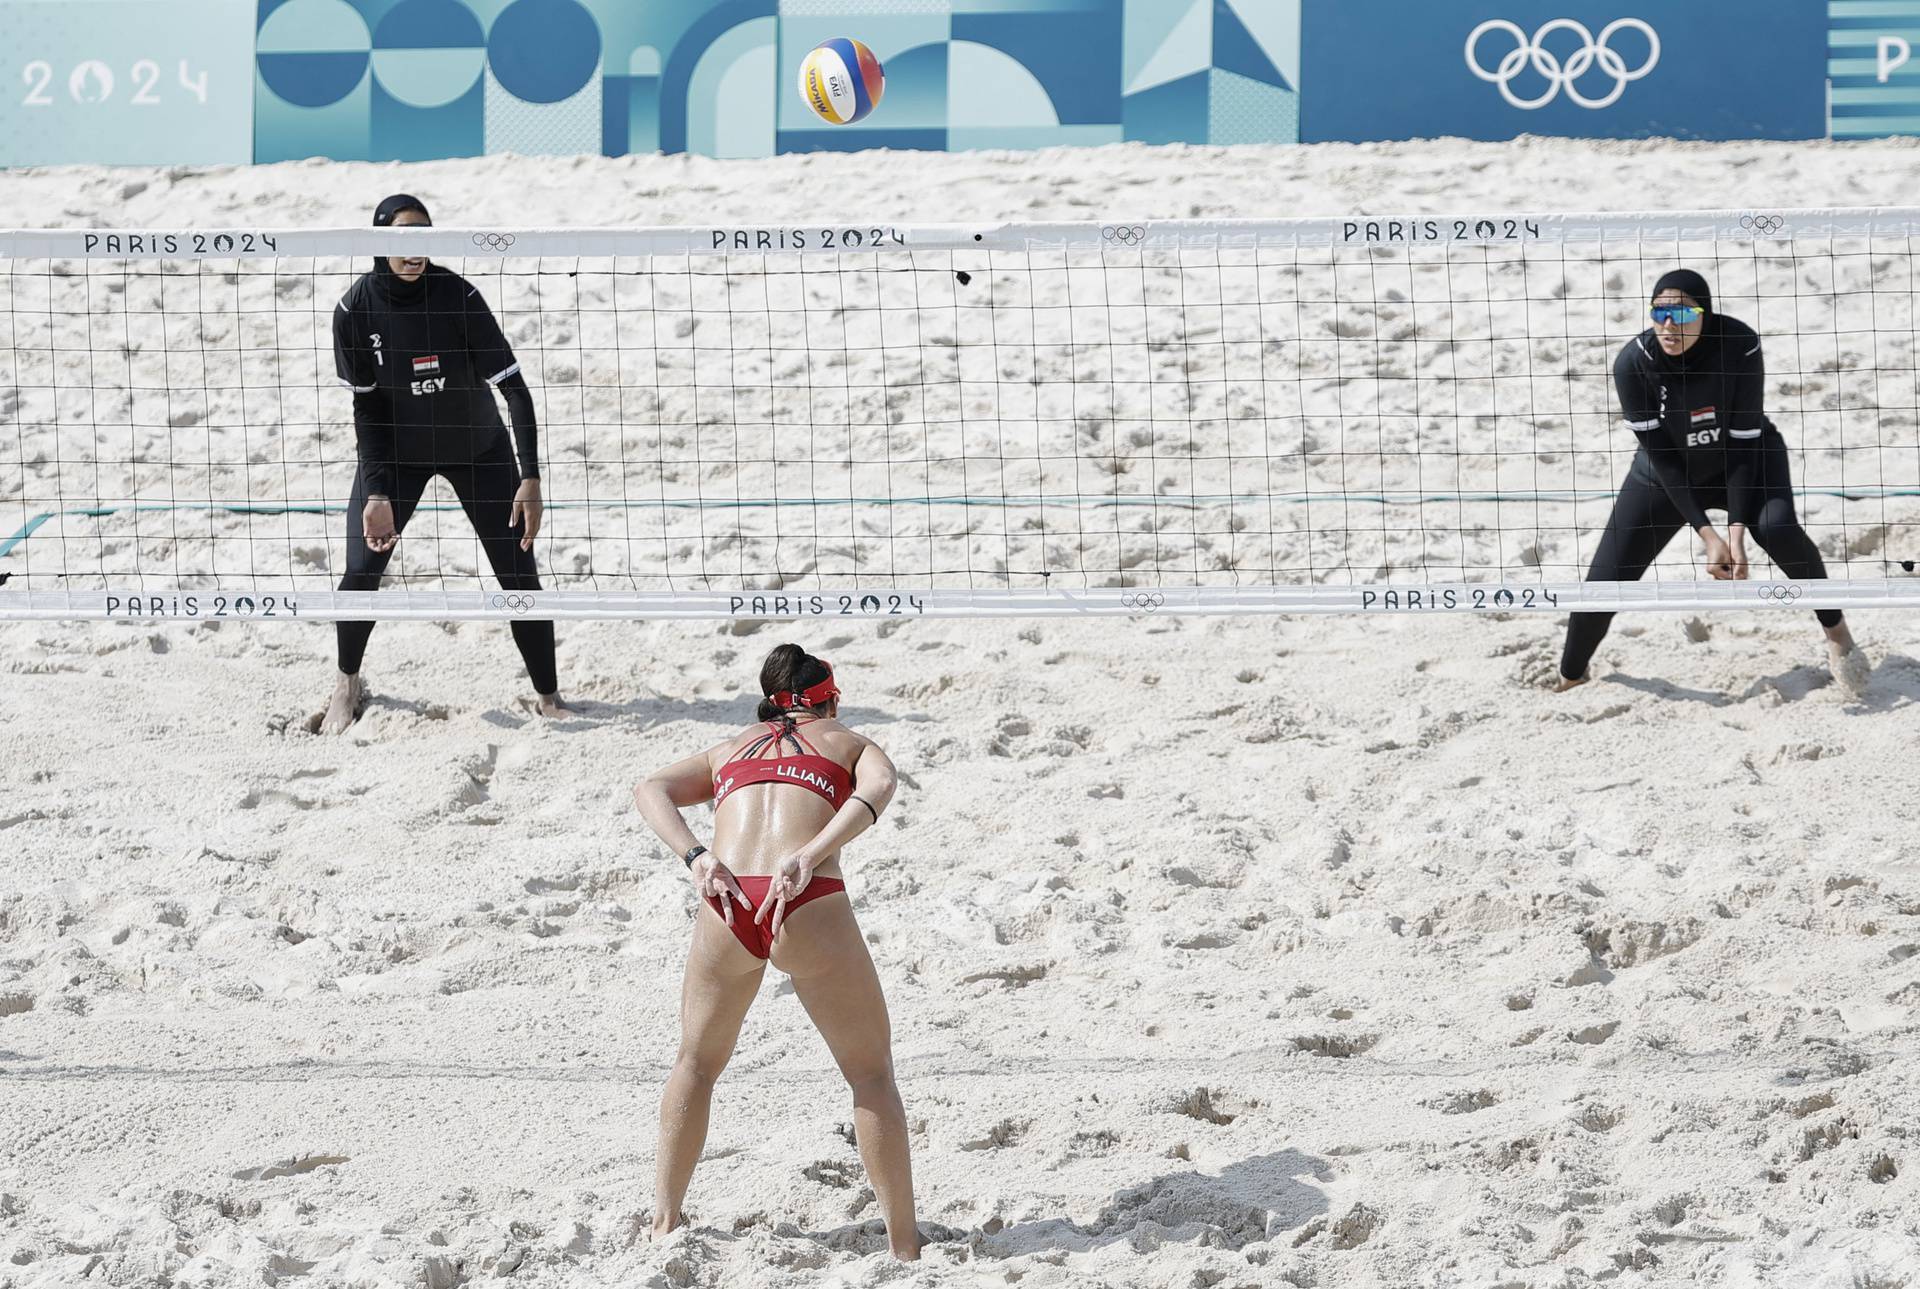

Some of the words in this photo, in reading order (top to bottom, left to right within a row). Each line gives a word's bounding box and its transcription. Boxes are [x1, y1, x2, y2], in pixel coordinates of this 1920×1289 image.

[1876, 35, 1912, 84] P
[21, 58, 208, 106] 2024
[820, 228, 905, 249] 2024
[1453, 219, 1539, 240] 2024
[192, 233, 277, 254] 2024
[373, 350, 384, 366] 1
[410, 376, 446, 396] EGY
[1686, 427, 1722, 447] EGY
[213, 596, 297, 617] 2024
[838, 594, 923, 615] 2024
[1472, 588, 1557, 609] 2024
[776, 764, 836, 799] LILIANA
